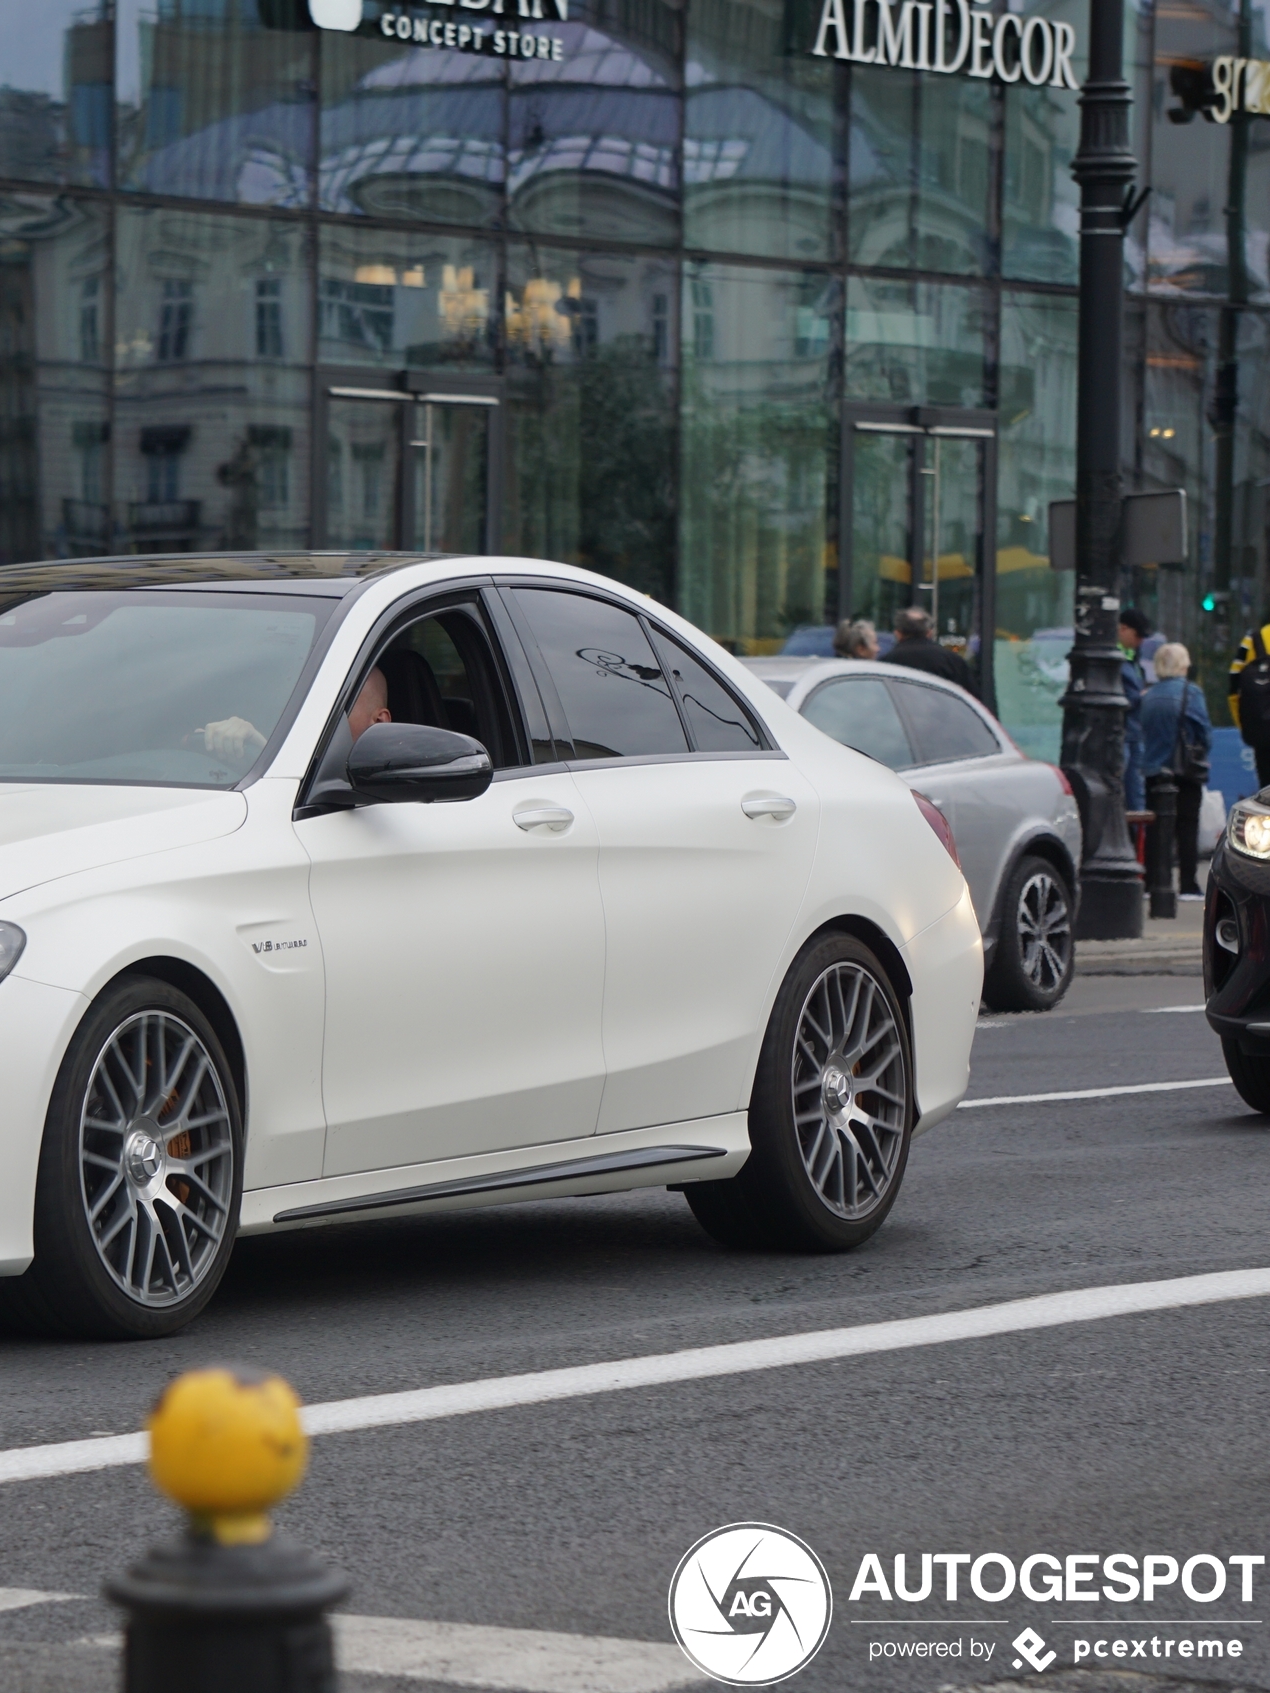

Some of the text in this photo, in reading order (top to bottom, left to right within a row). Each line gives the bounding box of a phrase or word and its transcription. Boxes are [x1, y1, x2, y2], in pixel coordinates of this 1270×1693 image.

[381, 12, 565, 62] CONCEPT STORE
[812, 0, 1080, 91] ALMIDECOR
[251, 940, 273, 954] V8
